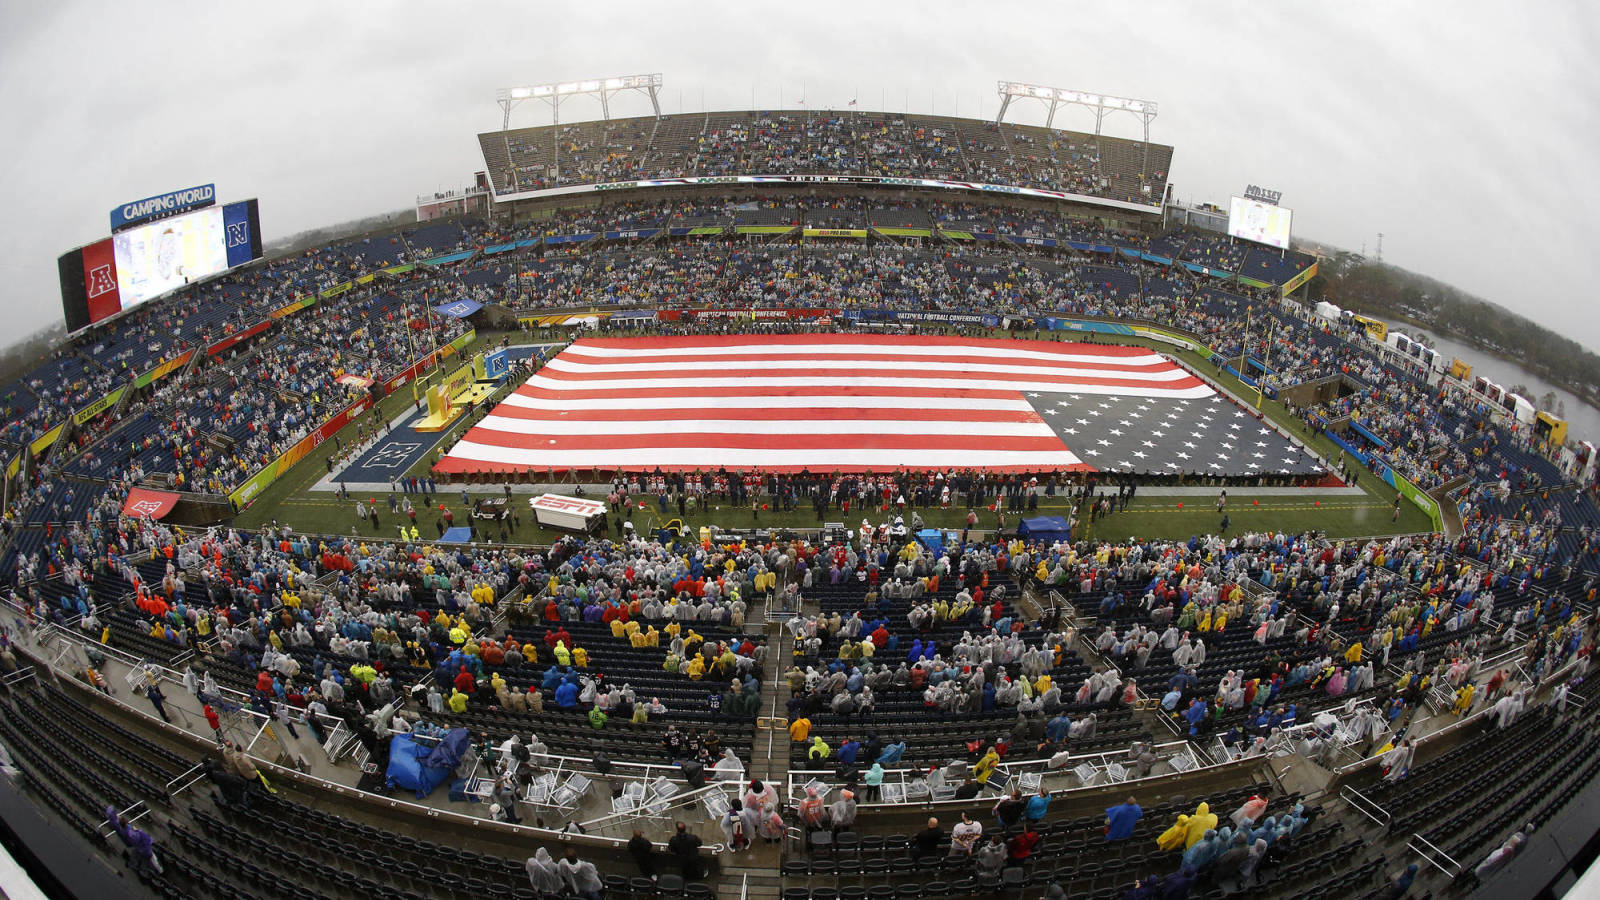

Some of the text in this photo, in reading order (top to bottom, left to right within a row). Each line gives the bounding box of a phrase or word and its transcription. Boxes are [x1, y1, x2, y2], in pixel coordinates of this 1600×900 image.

[1245, 184, 1282, 200] MASSEY
[123, 186, 213, 220] CAMPING WORLD
[89, 263, 116, 299] A
[897, 312, 982, 322] NATIONAL FOOTBALL CONFERENCE
[535, 496, 601, 514] ESPN
